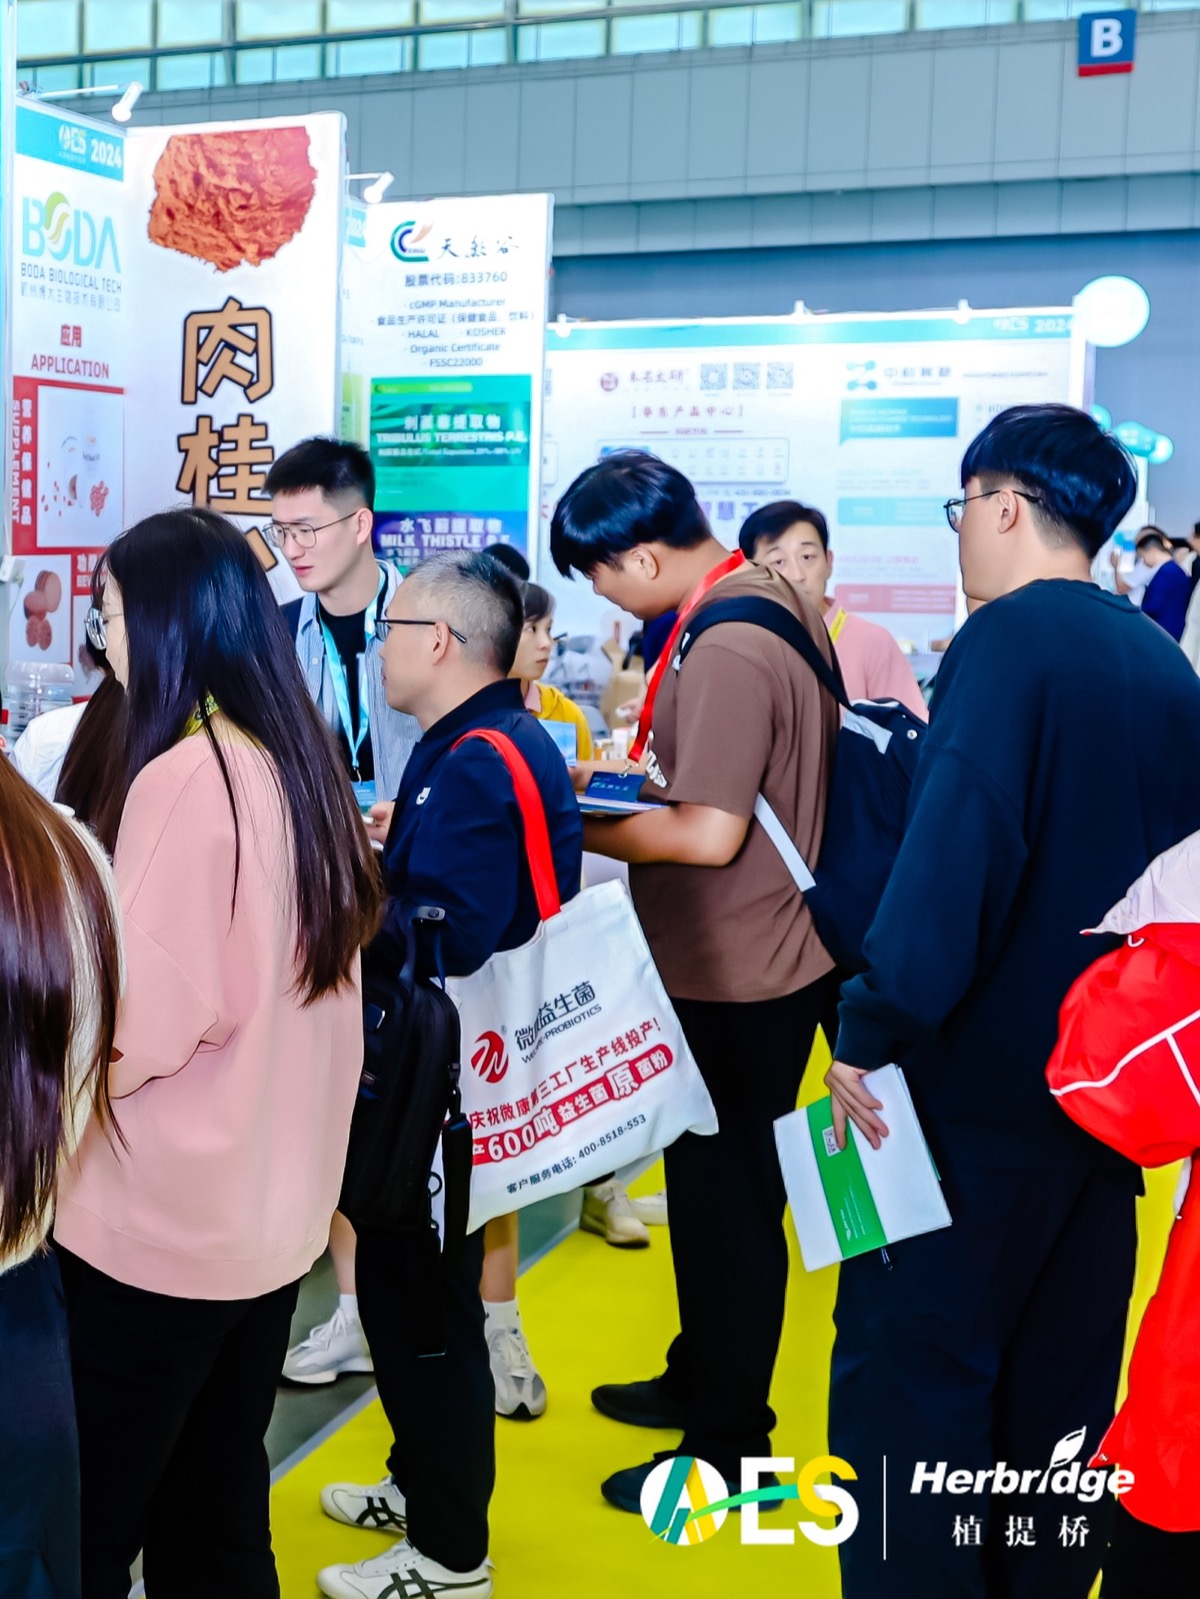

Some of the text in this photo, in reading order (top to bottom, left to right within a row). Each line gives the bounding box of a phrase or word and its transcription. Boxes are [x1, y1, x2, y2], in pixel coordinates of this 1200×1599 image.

[1090, 18, 1123, 58] B
[91, 138, 122, 169] 2024
[22, 191, 122, 274] BODA
[21, 262, 121, 294] BODA BIOLOGICAL TECH
[439, 298, 506, 308] Manufacturer
[60, 324, 82, 348] 应用
[408, 327, 506, 338] HALAL KOSHER
[410, 341, 501, 355] Organic Certificate
[31, 353, 110, 380] APPLICATION
[176, 295, 278, 571] 肉桂
[380, 534, 415, 547] MILK
[421, 534, 482, 548] THISTLE
